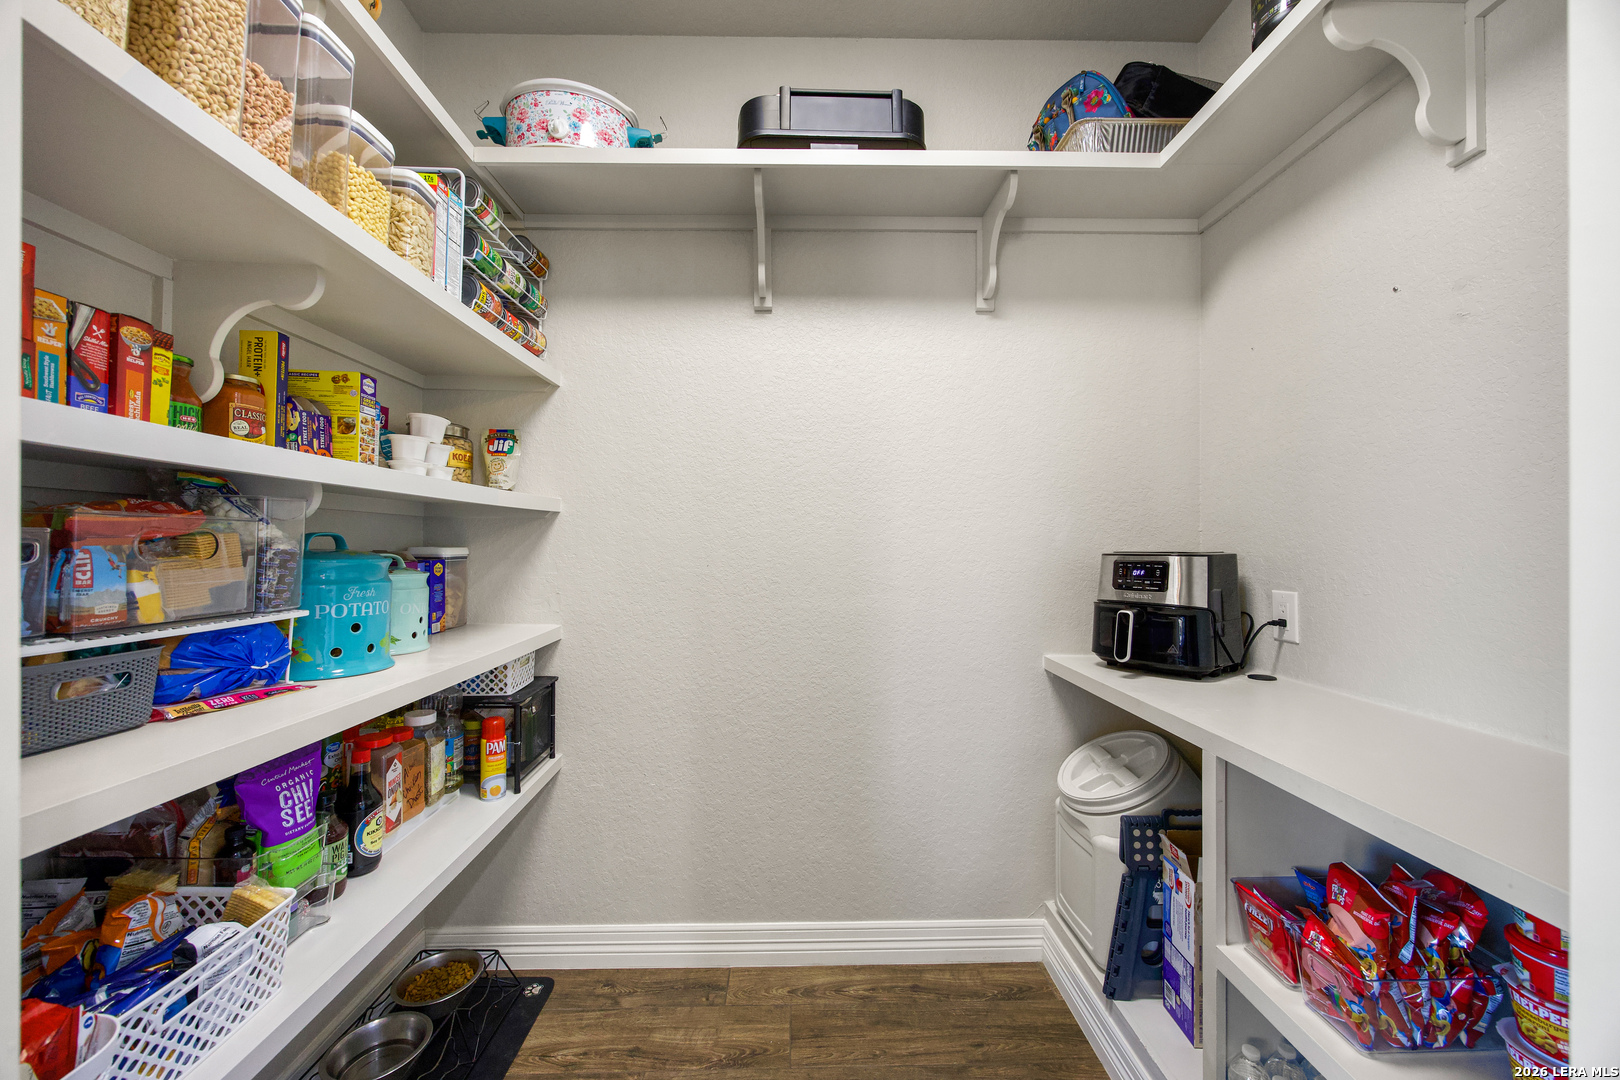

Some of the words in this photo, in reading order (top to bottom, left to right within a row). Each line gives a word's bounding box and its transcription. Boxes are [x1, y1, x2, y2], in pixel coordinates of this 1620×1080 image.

[254, 336, 263, 377] PROTEIN+
[488, 440, 514, 452] Jif
[343, 586, 376, 600] Fresh
[315, 600, 390, 620] POTATO
[208, 696, 235, 706] ZERO
[486, 741, 506, 755] PAM
[275, 769, 314, 792] ORGANIC
[281, 796, 314, 828] SEE
[367, 826, 383, 836] KIKKO
[1332, 884, 1348, 896] FROOT
[1332, 892, 1345, 906] LOOPS
[1513, 990, 1569, 1028] HELPER
